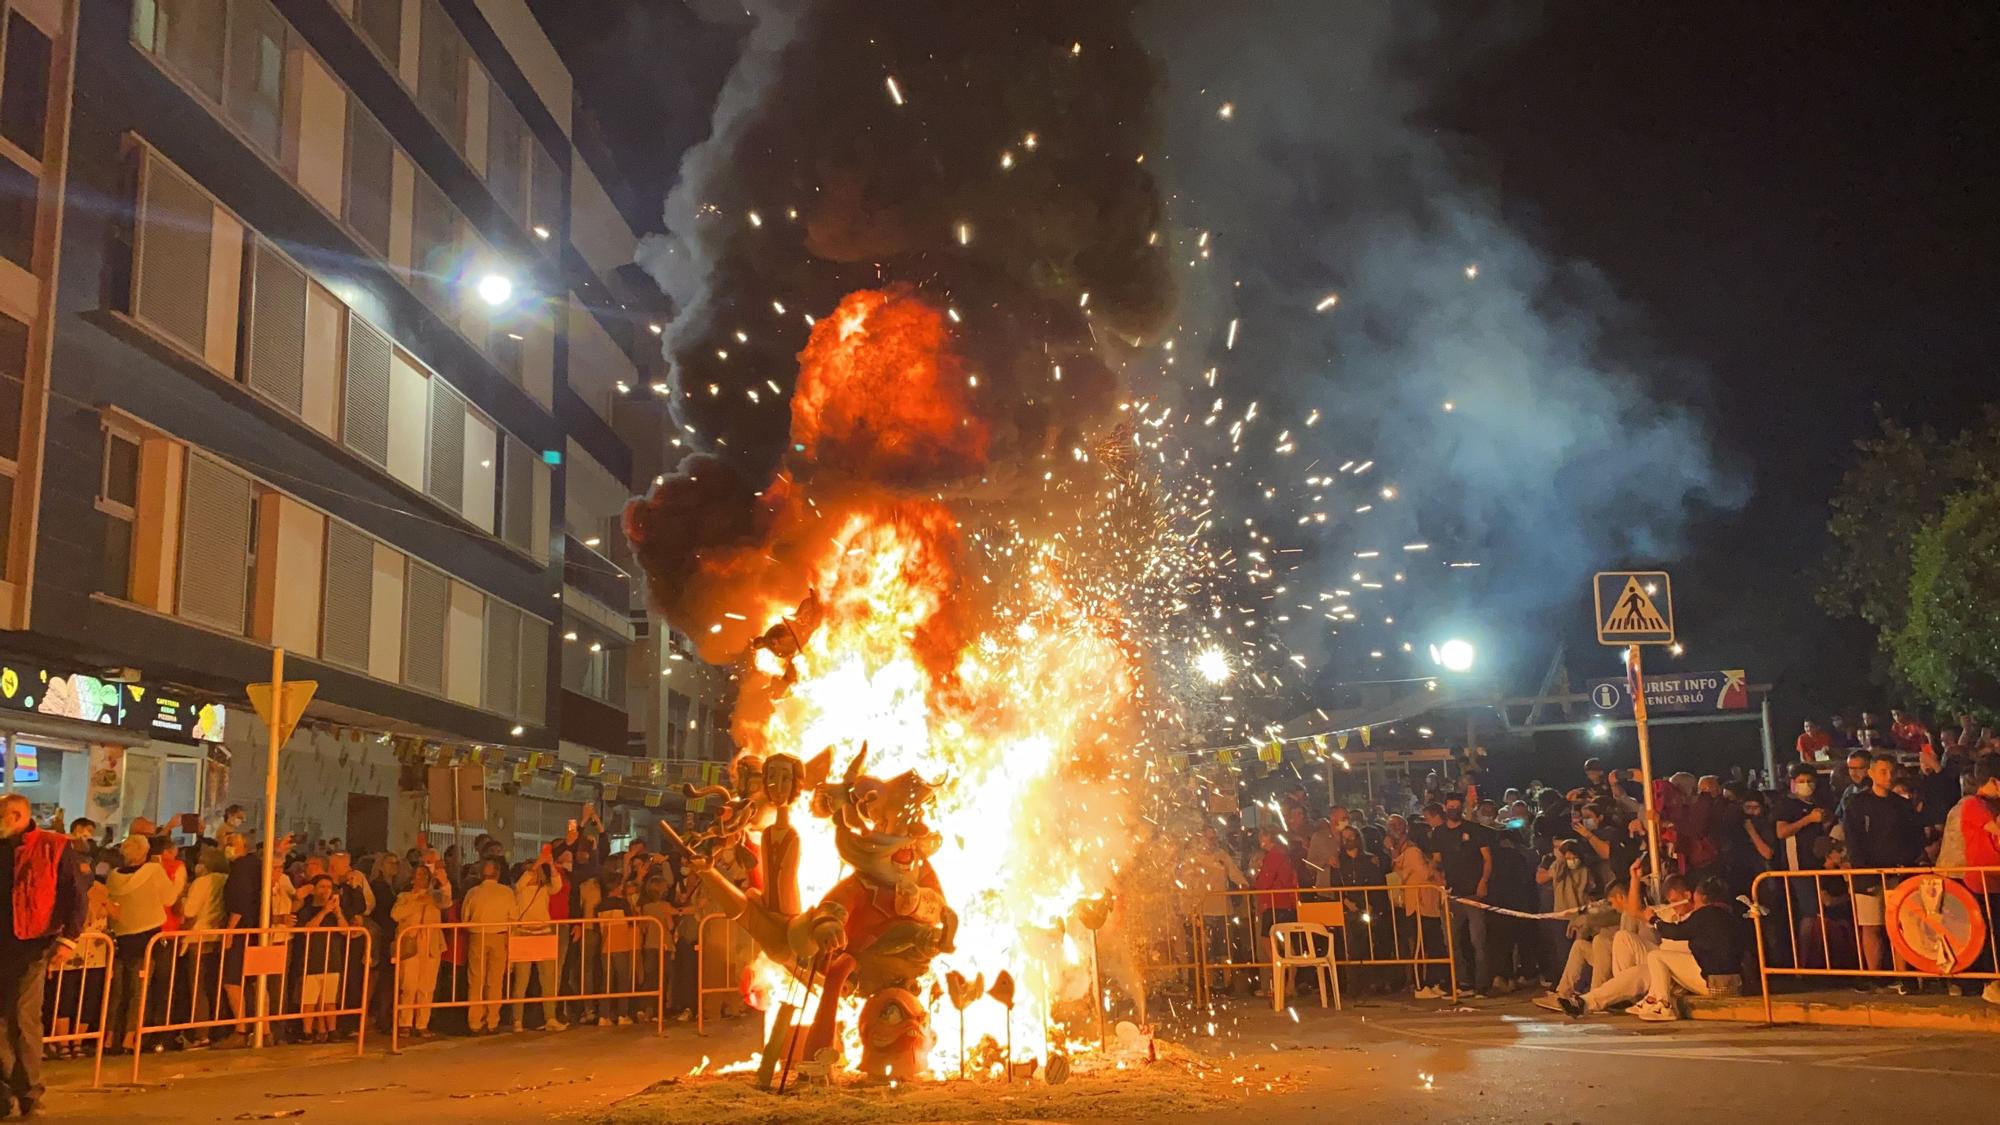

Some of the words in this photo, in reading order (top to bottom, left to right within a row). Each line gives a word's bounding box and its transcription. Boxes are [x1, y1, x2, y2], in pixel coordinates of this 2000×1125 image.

[1624, 681, 1680, 694] TURIST
[1684, 678, 1717, 690] INFO
[1645, 690, 1704, 706] ENICARLÓ
